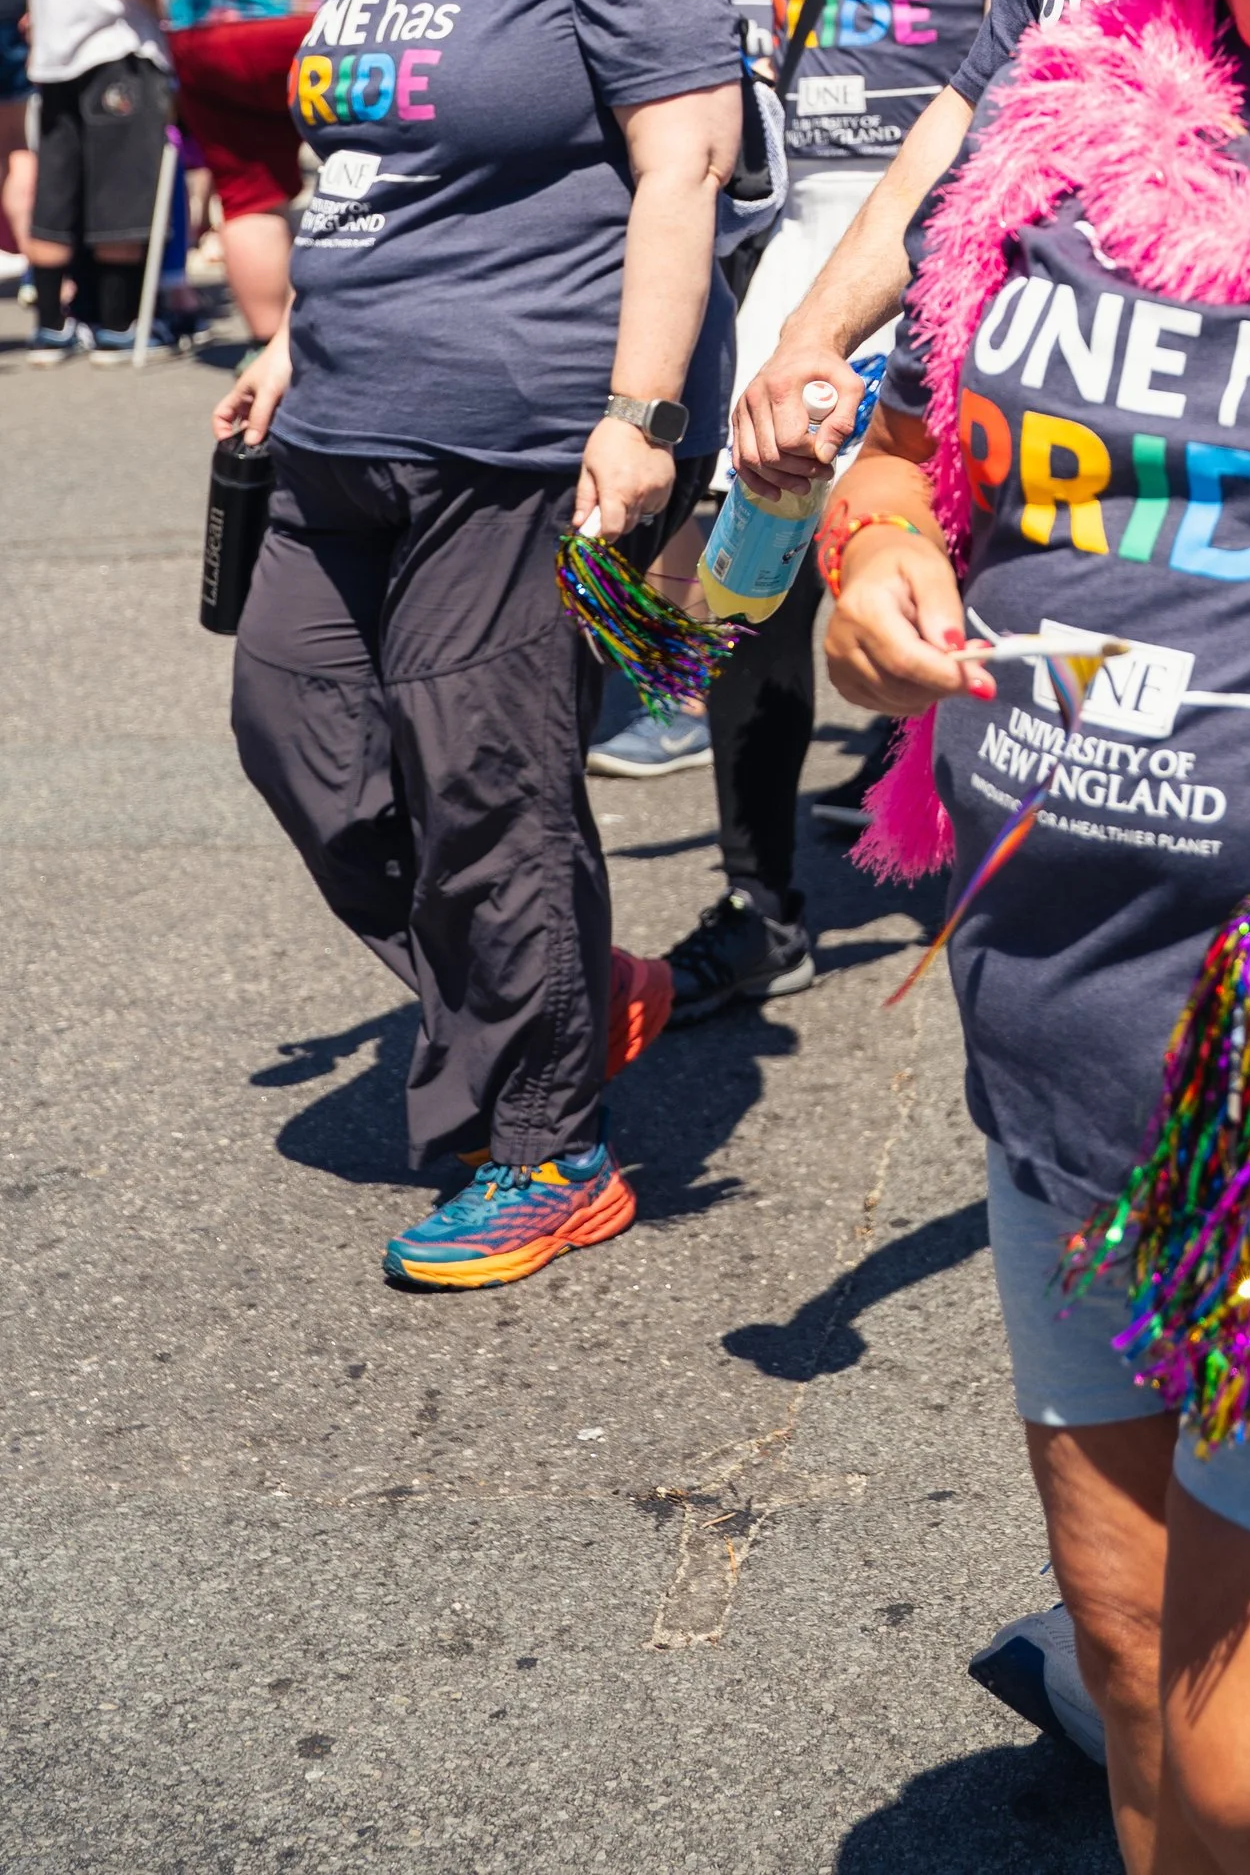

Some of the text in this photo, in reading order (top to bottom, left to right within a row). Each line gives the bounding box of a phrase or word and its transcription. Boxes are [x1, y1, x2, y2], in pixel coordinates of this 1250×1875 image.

[287, 49, 442, 125] RIDE
[975, 276, 1202, 418] UNE
[1073, 657, 1168, 713] NE
[978, 722, 1227, 823] NEW ENGLAND
[1009, 707, 1196, 780] UNIVERSITY OF
[1069, 817, 1156, 847] HEALTHIER
[1157, 832, 1223, 858] PLANET
